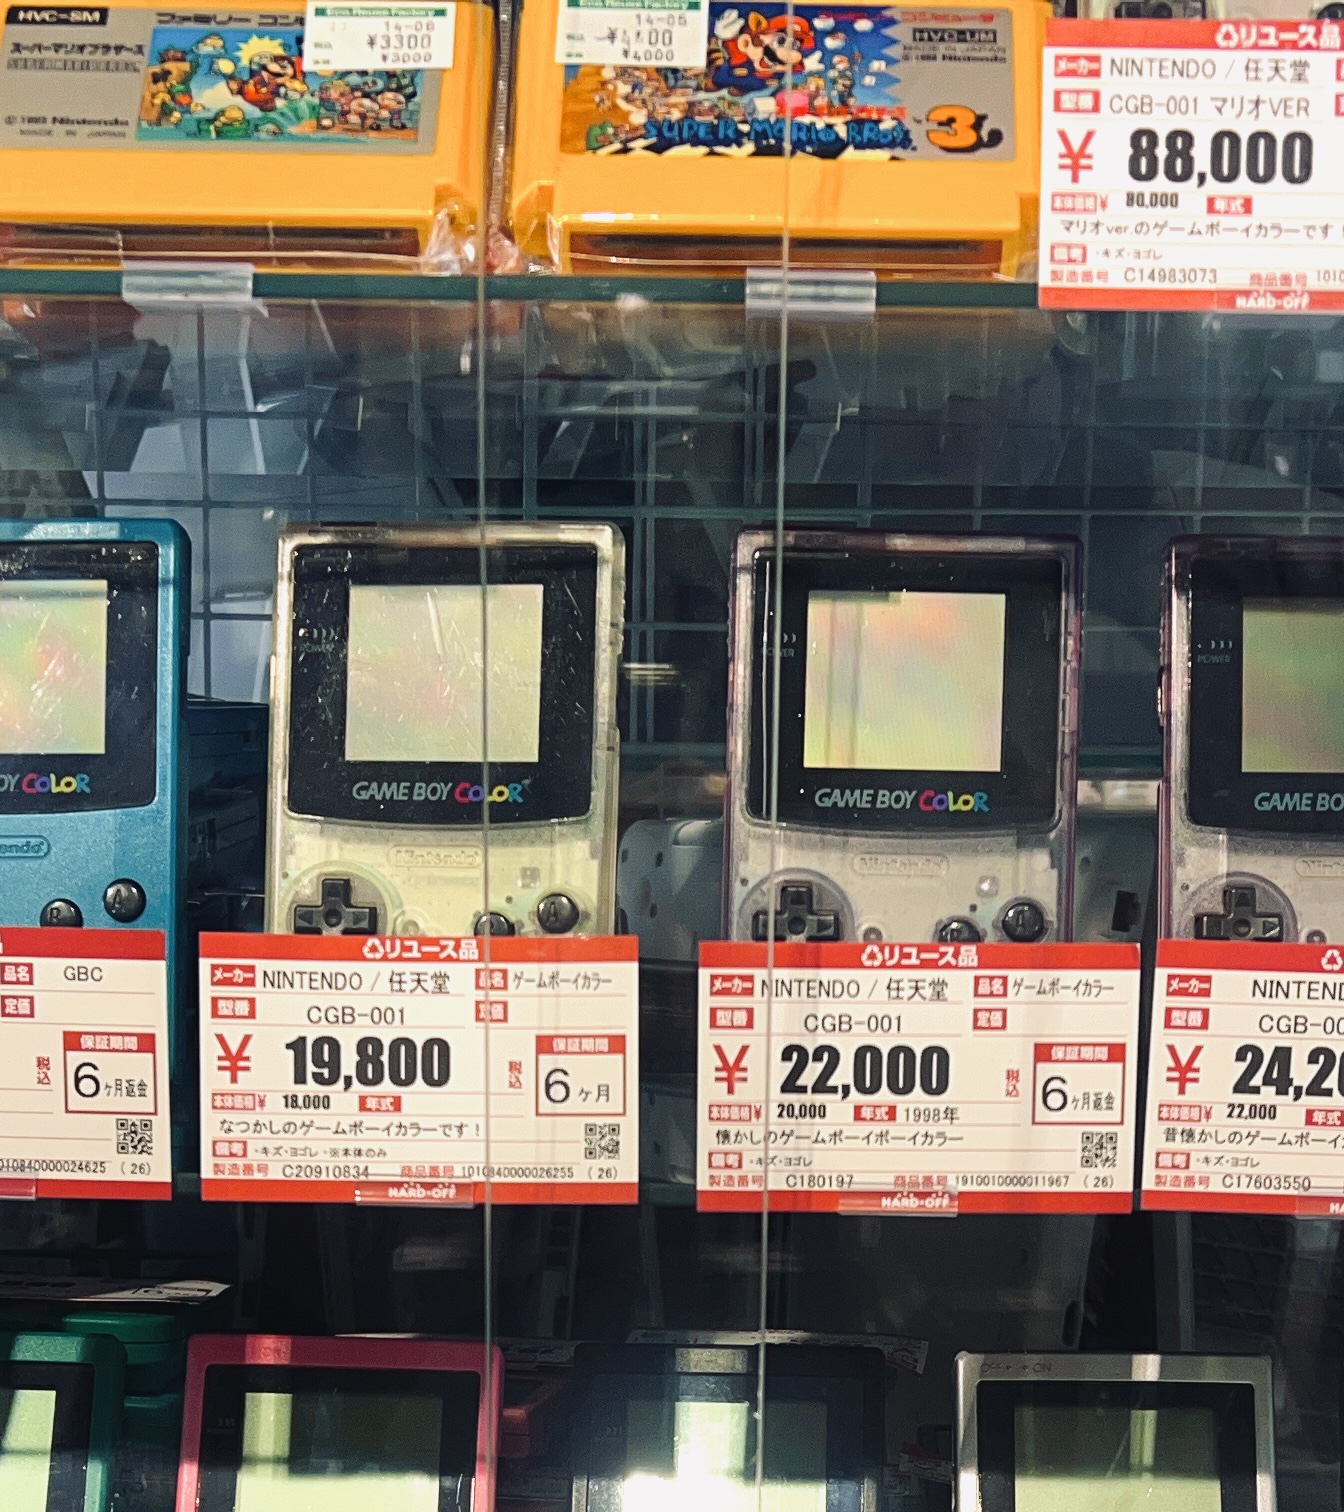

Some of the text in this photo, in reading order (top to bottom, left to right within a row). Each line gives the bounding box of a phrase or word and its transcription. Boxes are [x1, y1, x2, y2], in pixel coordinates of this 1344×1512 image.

[366, 33, 432, 52] ¥3300
[622, 48, 675, 64] ¥4000
[1109, 58, 1311, 84] NINTENDO 任天堂
[1109, 95, 1310, 120] CGB-001 マリオVER
[644, 115, 837, 145] SUPER MARIO
[925, 104, 987, 153] 3
[1128, 128, 1314, 188] 88,000
[21, 773, 92, 796] COLOR
[63, 965, 103, 983] GBC
[760, 978, 861, 999] NINTENDO
[804, 1014, 903, 1034] CGB-001
[780, 1044, 950, 1100] 22,000
